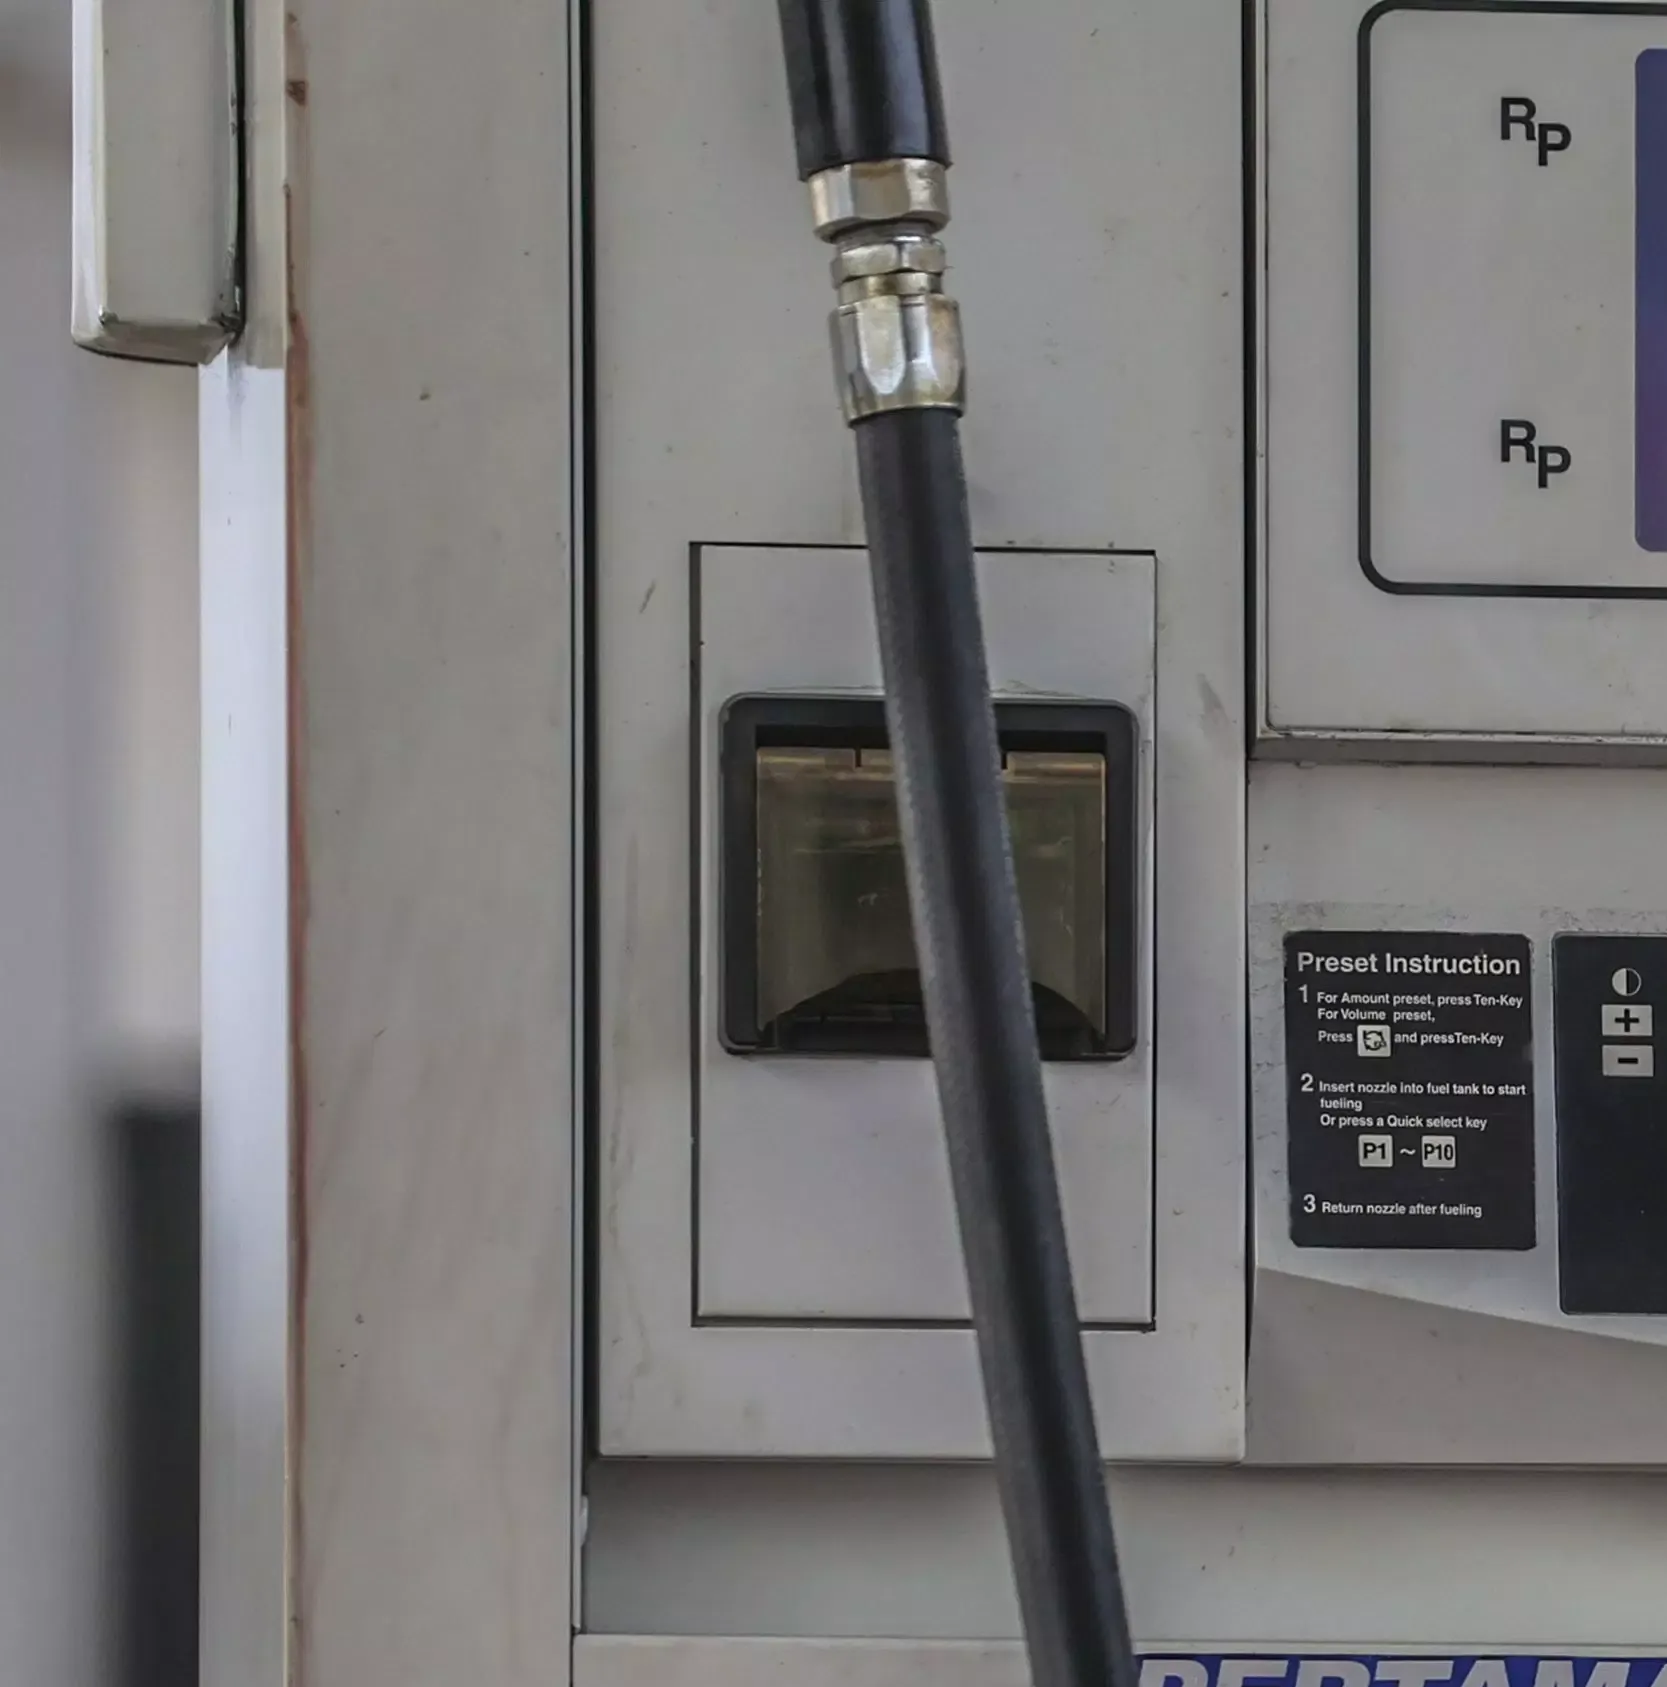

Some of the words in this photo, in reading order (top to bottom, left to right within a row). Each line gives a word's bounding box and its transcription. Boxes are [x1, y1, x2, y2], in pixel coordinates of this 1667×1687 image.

[1299, 953, 1378, 972] Preset
[1386, 953, 1519, 974] Instruction
[1299, 984, 1307, 1003] 1
[1317, 992, 1337, 1003] For
[1341, 993, 1389, 1003] Amount
[1393, 994, 1434, 1006] preset,
[1438, 996, 1471, 1007] press
[1474, 994, 1522, 1008] Ten-Key
[1318, 1008, 1338, 1019] For
[1341, 1008, 1386, 1020] Volume
[1394, 1010, 1435, 1022] preset,
[1319, 1031, 1352, 1042] Press
[1395, 1032, 1417, 1043] and
[1301, 1073, 1313, 1091] 2
[1320, 1081, 1354, 1092] Insert
[1358, 1082, 1397, 1093] nozzle
[1401, 1082, 1423, 1093] into
[1427, 1083, 1449, 1094] fuel
[1453, 1084, 1479, 1094] tank
[1483, 1085, 1494, 1094] to
[1498, 1085, 1525, 1095] start
[1321, 1098, 1362, 1111] fueling
[1321, 1114, 1336, 1125] Or
[1339, 1117, 1373, 1128] press
[1377, 1118, 1384, 1126] a
[1387, 1115, 1423, 1127] Quick
[1426, 1116, 1462, 1127] select
[1466, 1117, 1487, 1131] key
[1364, 1143, 1385, 1159] P1
[1424, 1144, 1453, 1160] P10
[1304, 1194, 1315, 1212] 3
[1322, 1202, 1363, 1213] Return
[1367, 1203, 1406, 1214] nozzle
[1409, 1204, 1437, 1214] after
[1440, 1204, 1481, 1218] fueling
